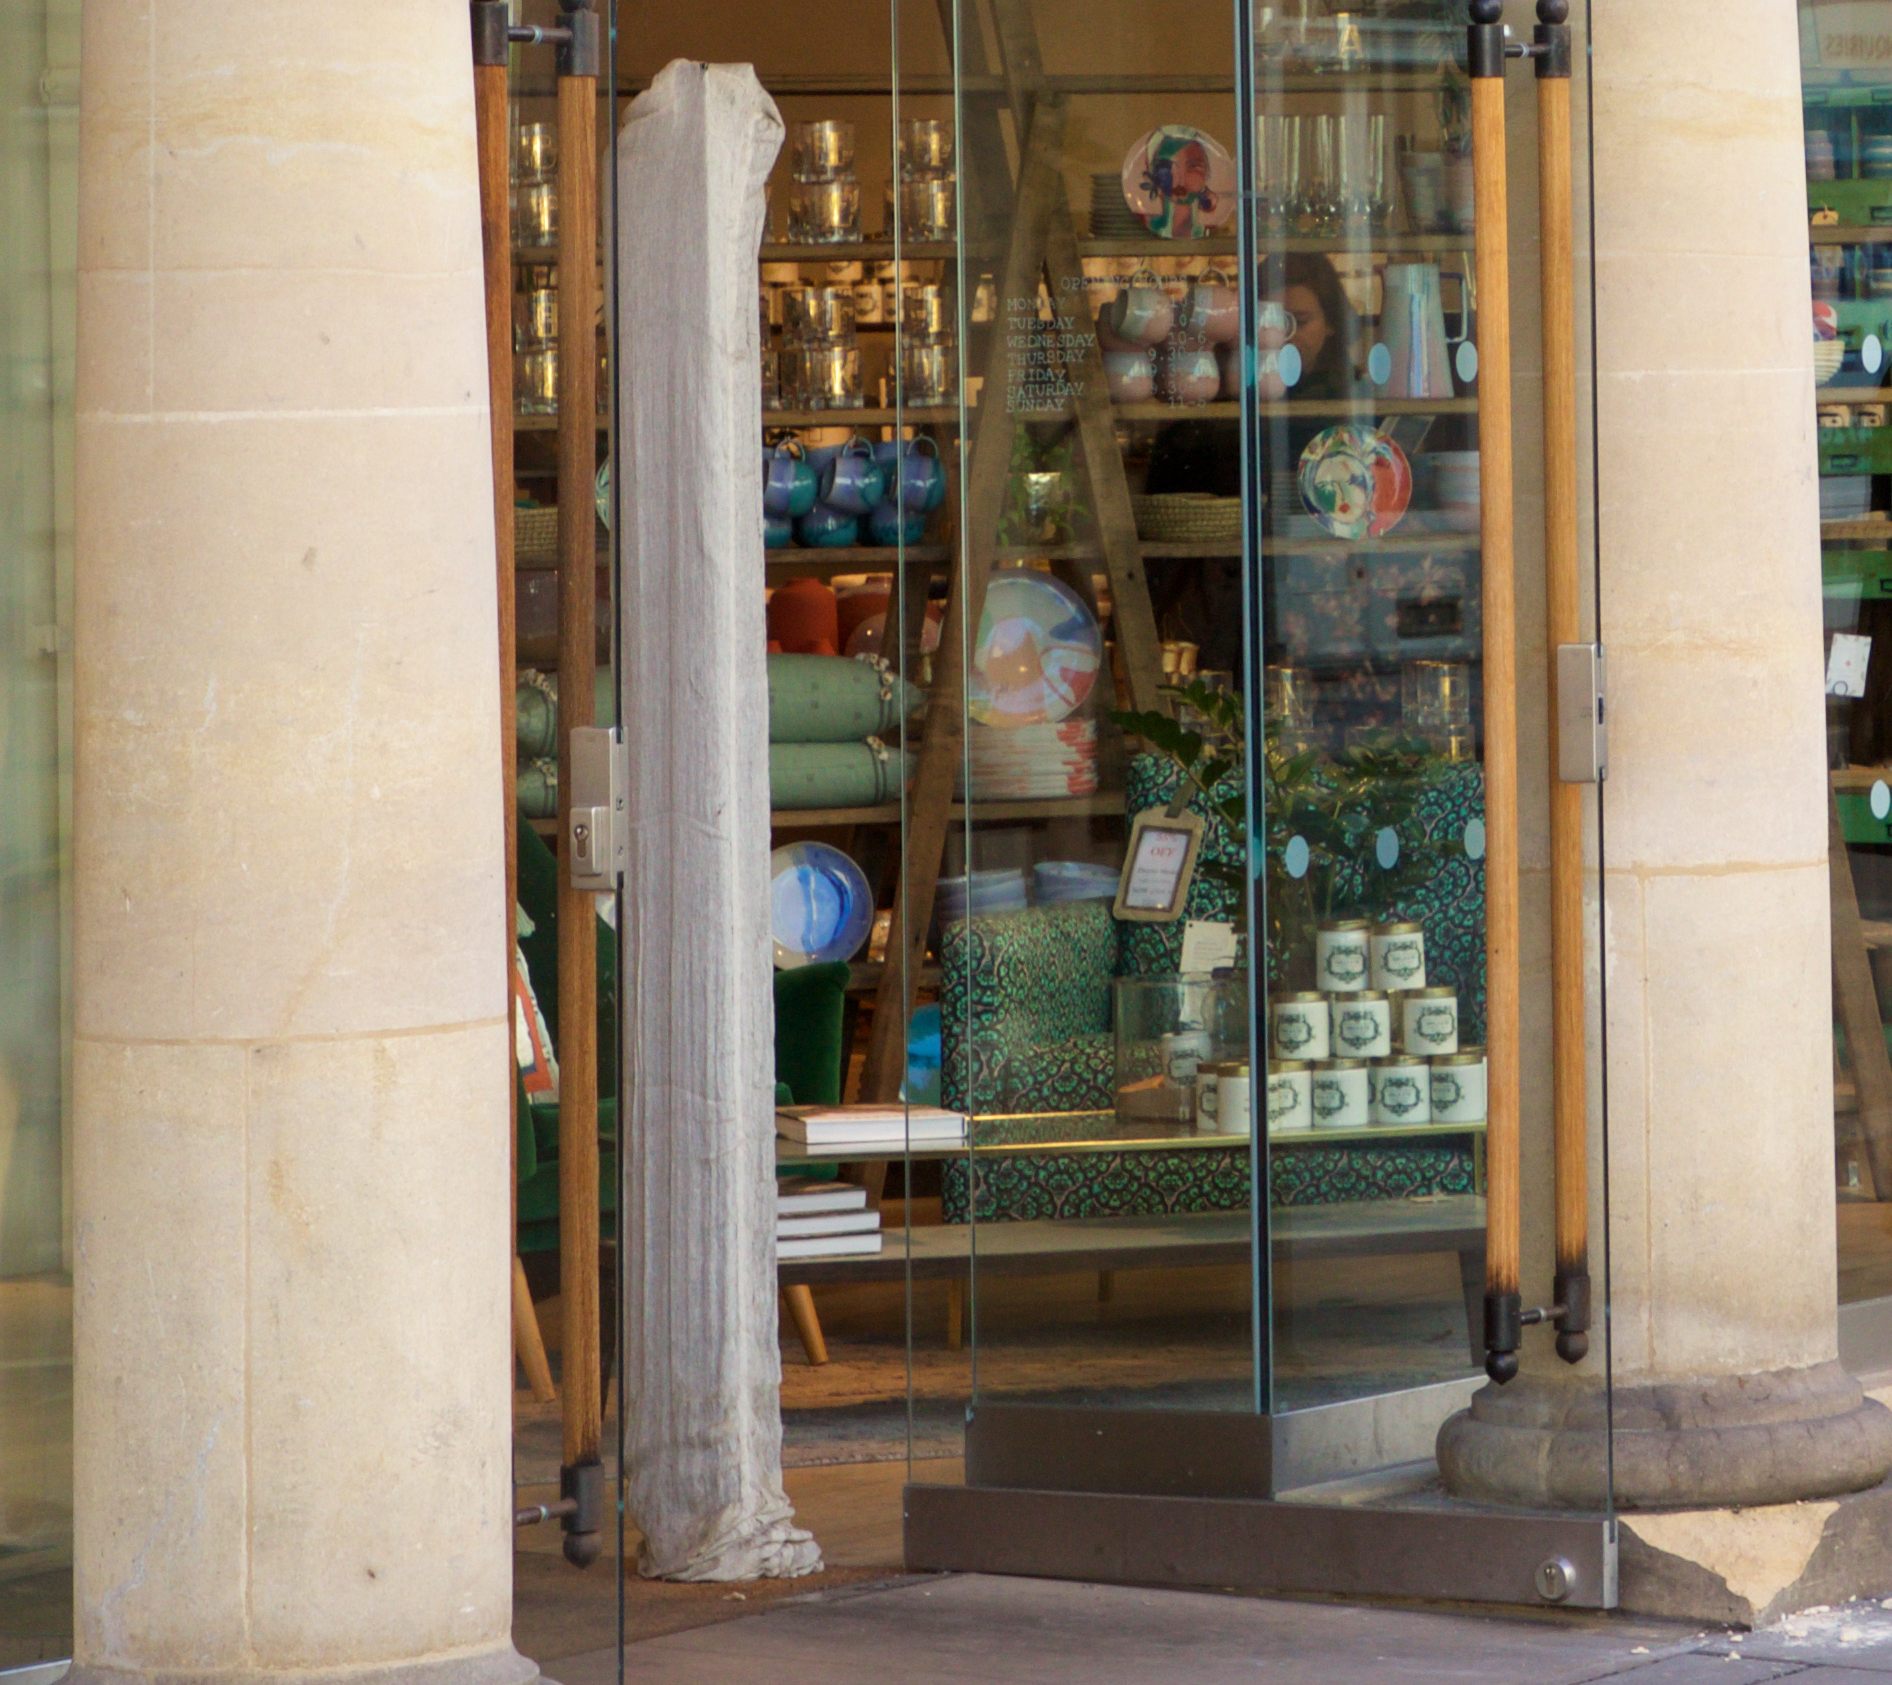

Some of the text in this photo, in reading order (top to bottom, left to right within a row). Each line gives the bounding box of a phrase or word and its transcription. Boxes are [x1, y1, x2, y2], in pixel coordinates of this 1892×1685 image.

[1006, 297, 1067, 312] MONDAY
[1007, 316, 1076, 330] TUESDAY
[1006, 333, 1097, 349] WEDNESDAY
[1007, 350, 1087, 366] THURSDAY
[1007, 367, 1067, 383] FRIDAY
[1007, 381, 1085, 399] SATURDAY
[1006, 398, 1067, 414] SUNDAY
